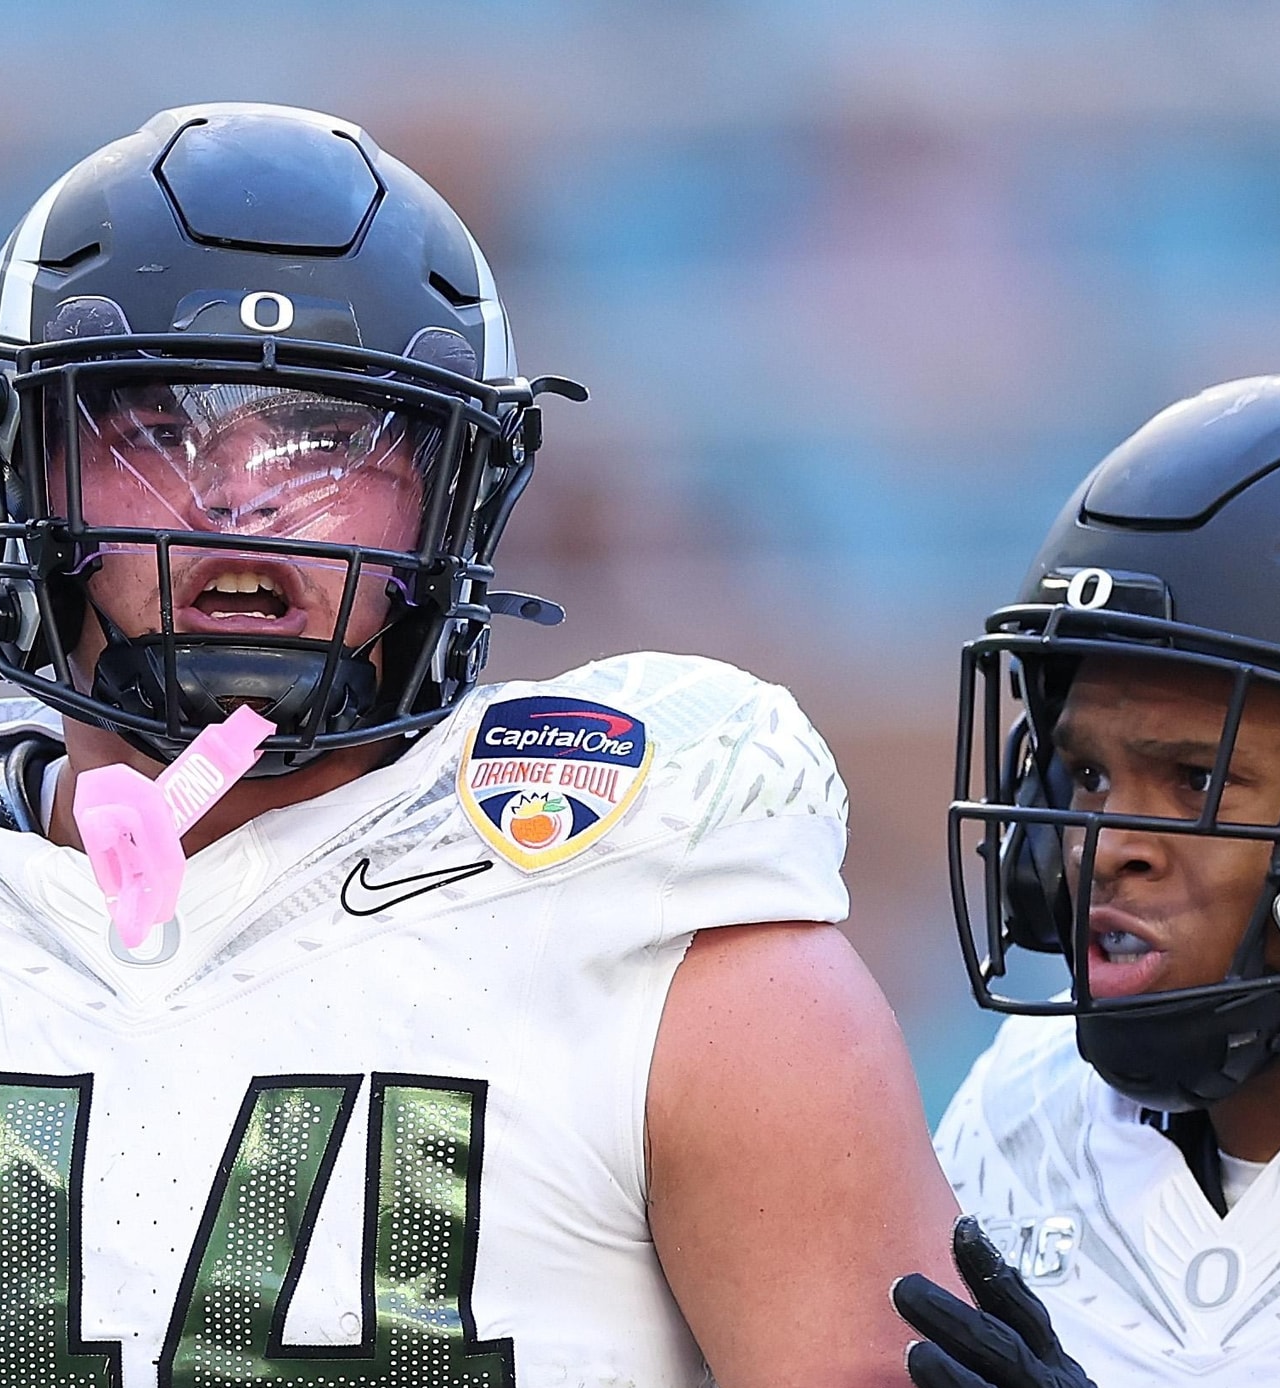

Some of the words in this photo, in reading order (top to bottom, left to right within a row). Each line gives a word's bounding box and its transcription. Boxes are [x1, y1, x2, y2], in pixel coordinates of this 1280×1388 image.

[239, 289, 295, 334] O
[1066, 567, 1113, 611] O
[470, 761, 554, 789] ORANGE
[558, 764, 620, 803] BOWL
[1185, 1246, 1240, 1309] O
